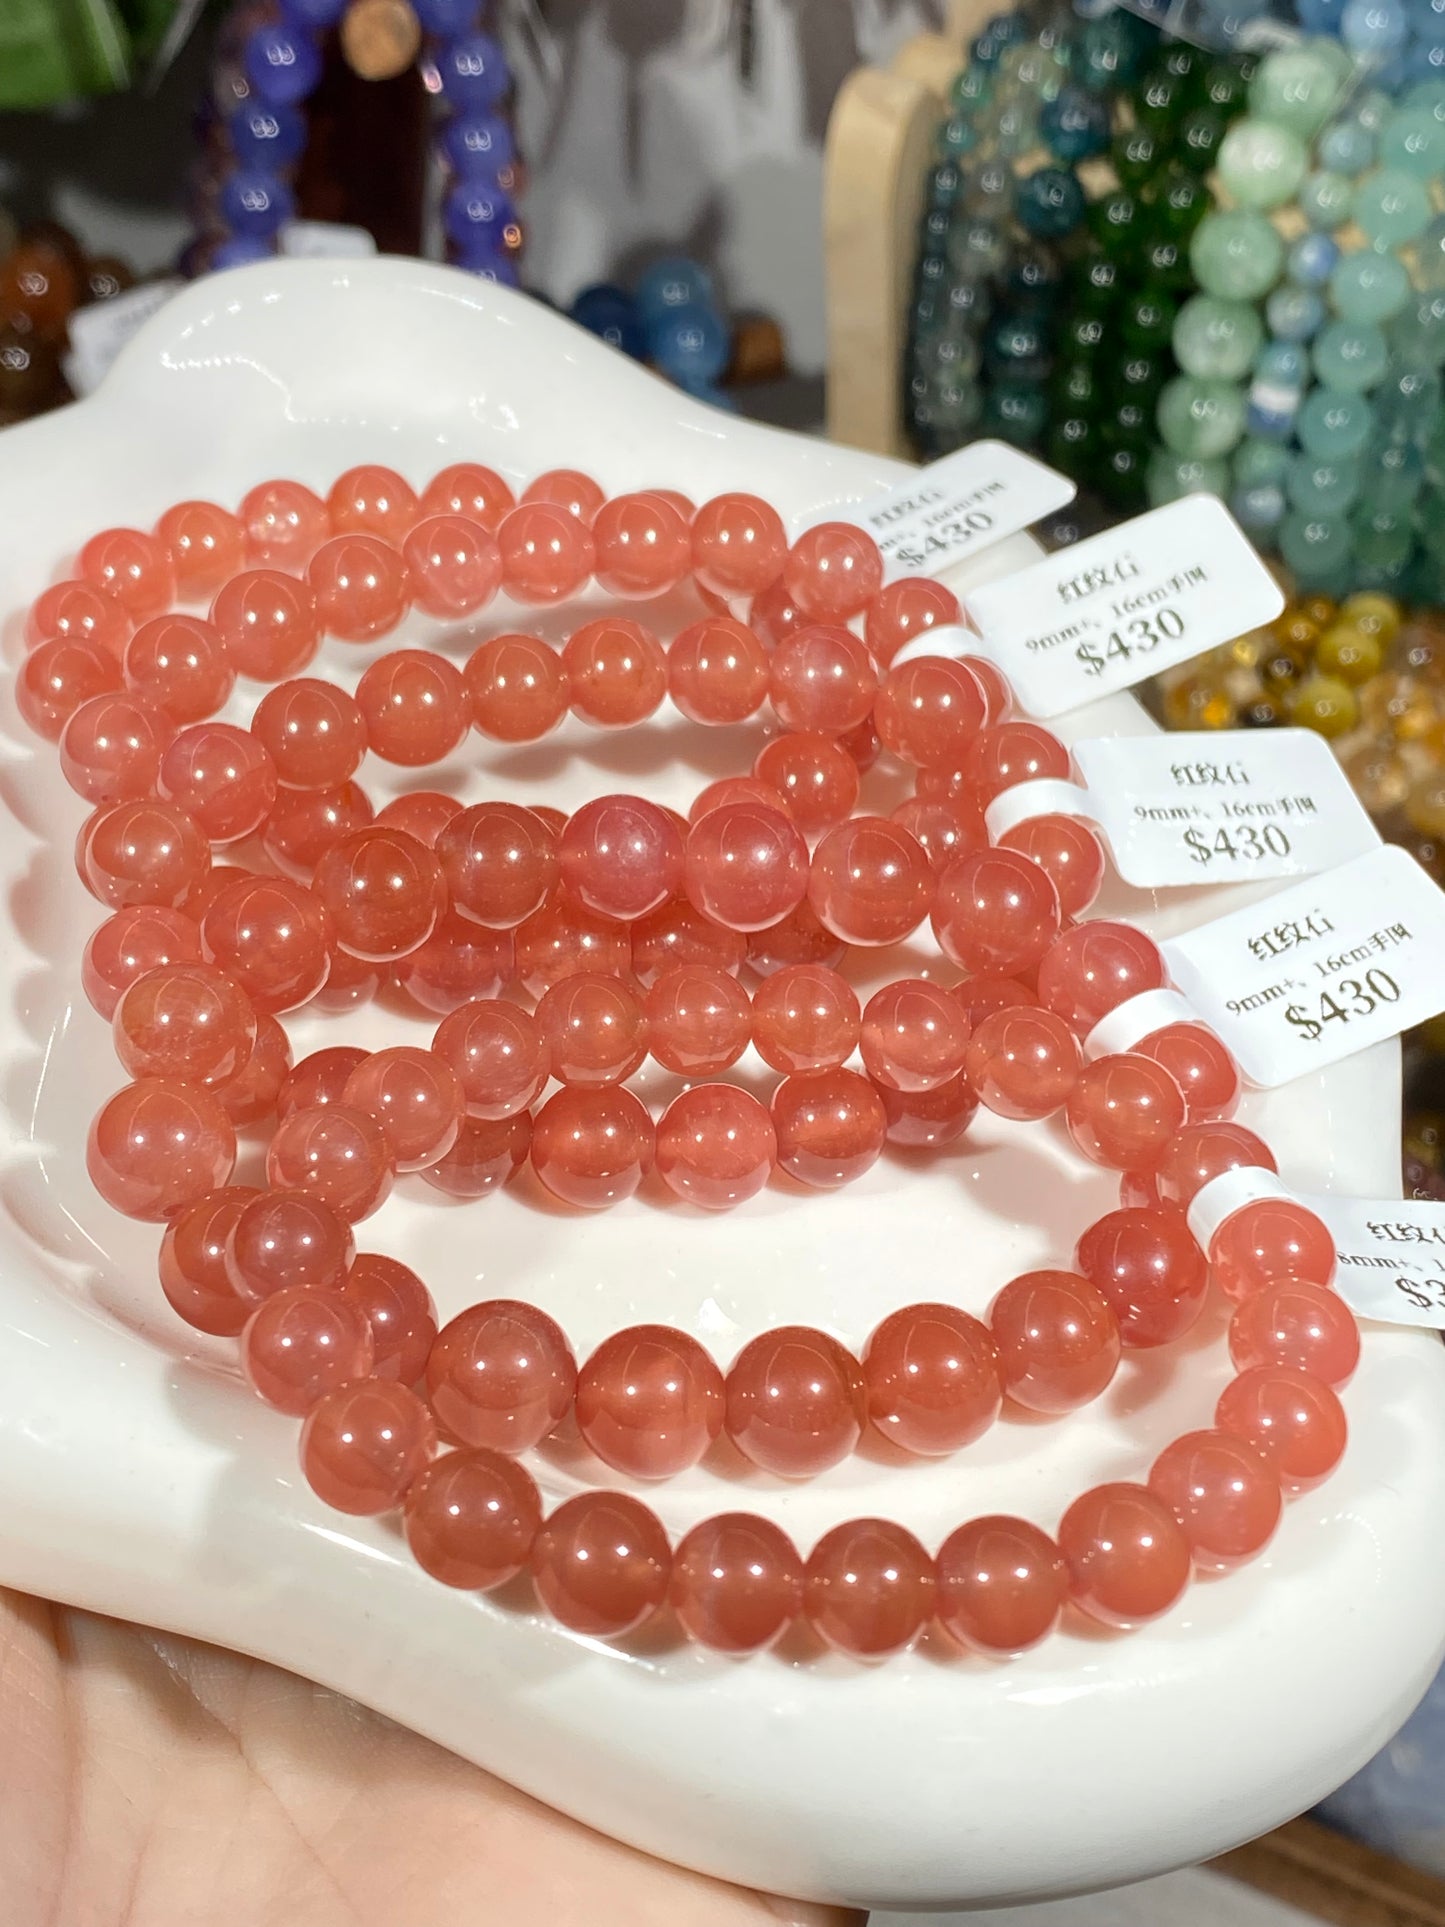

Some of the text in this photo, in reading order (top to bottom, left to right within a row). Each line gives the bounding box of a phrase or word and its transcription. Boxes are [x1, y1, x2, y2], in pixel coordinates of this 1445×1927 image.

[897, 512, 994, 567] $430
[1075, 608, 1185, 676] $430
[1182, 823, 1291, 868] $430
[1284, 968, 1401, 1042] $430
[1395, 1274, 1445, 1312] $3
